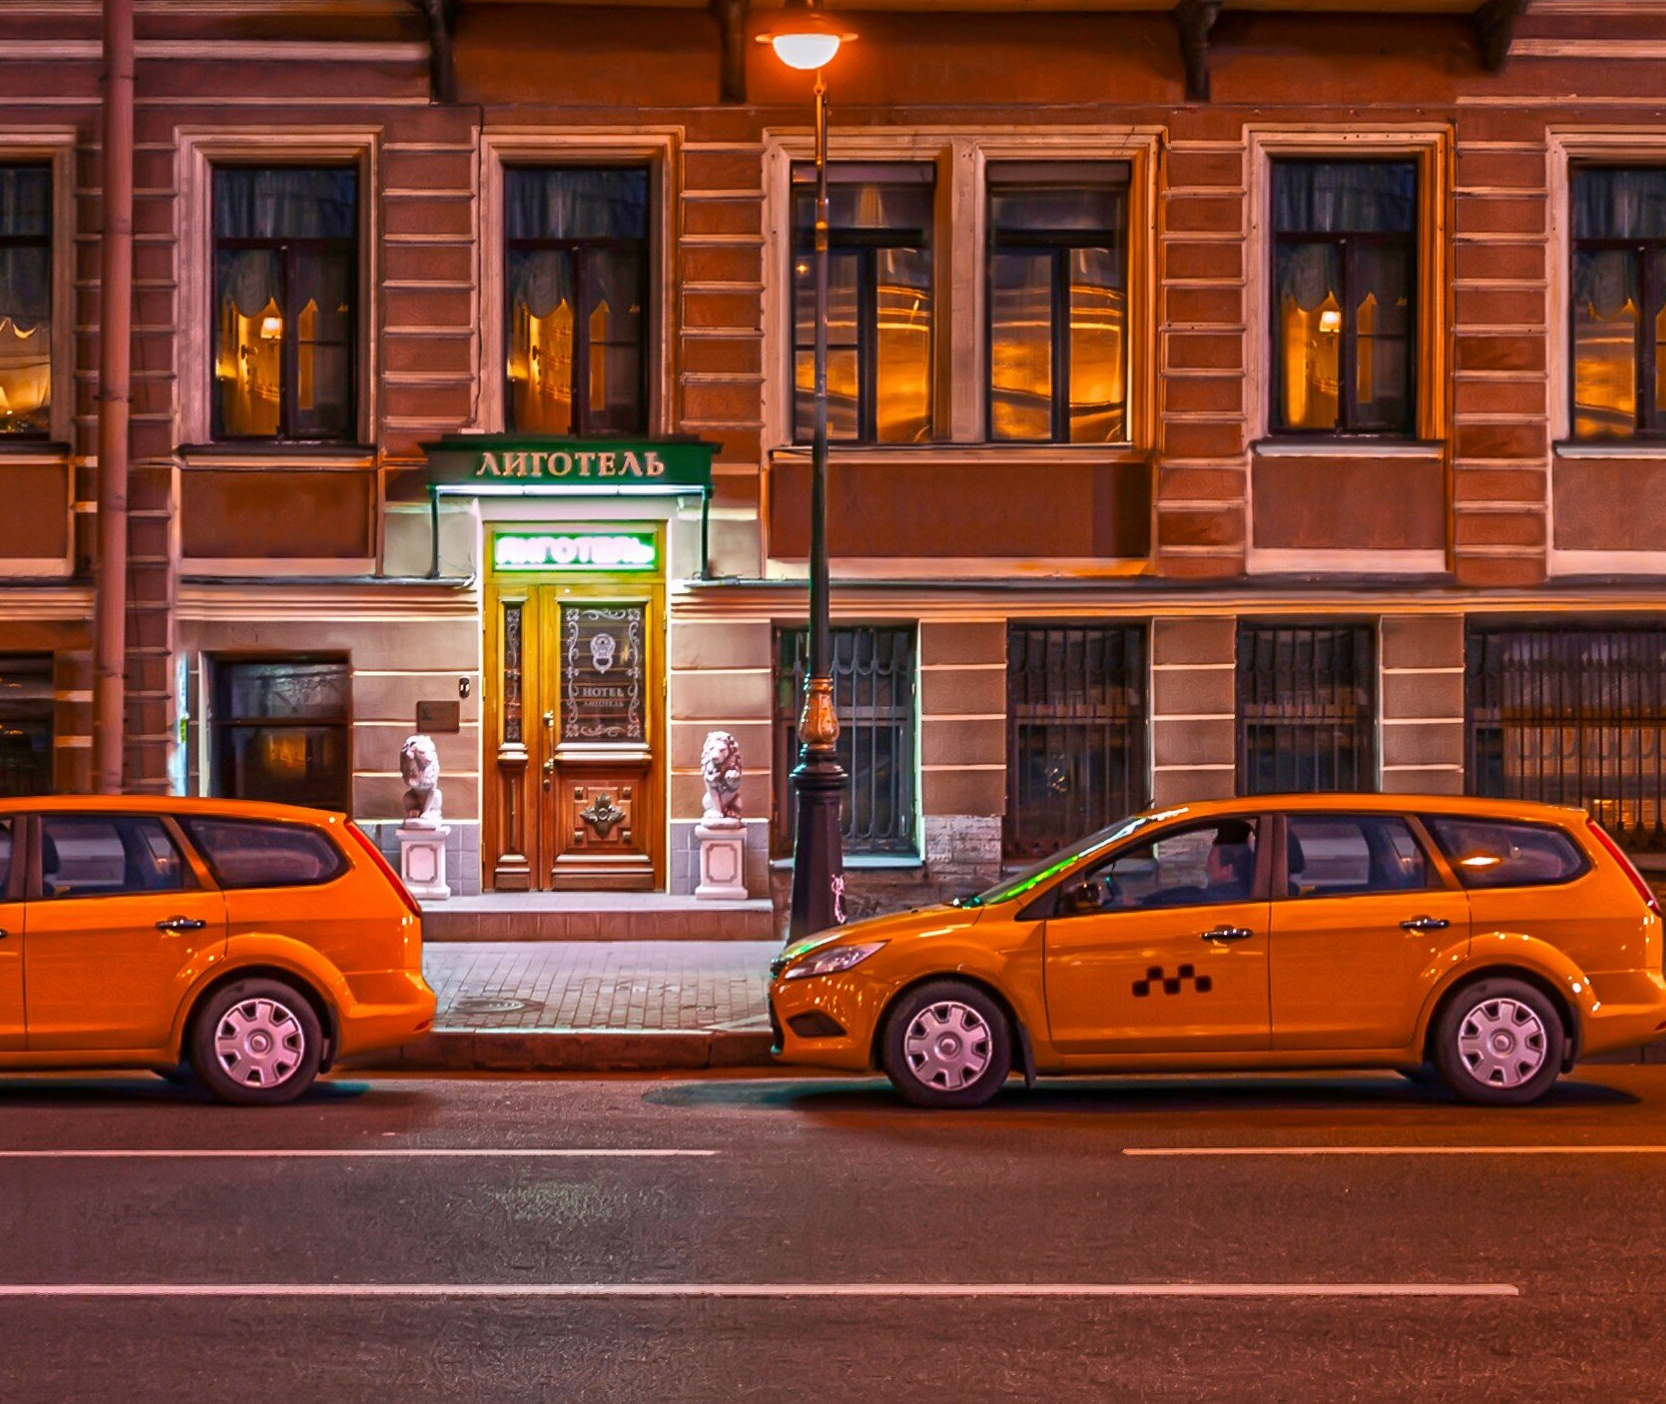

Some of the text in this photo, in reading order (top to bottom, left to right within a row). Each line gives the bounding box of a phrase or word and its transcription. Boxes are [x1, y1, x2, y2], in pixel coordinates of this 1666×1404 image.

[476, 451, 664, 477] ЛИГОТЕЛЬ
[496, 536, 655, 563] ГОТЬ
[582, 687, 625, 698] HOTEL
